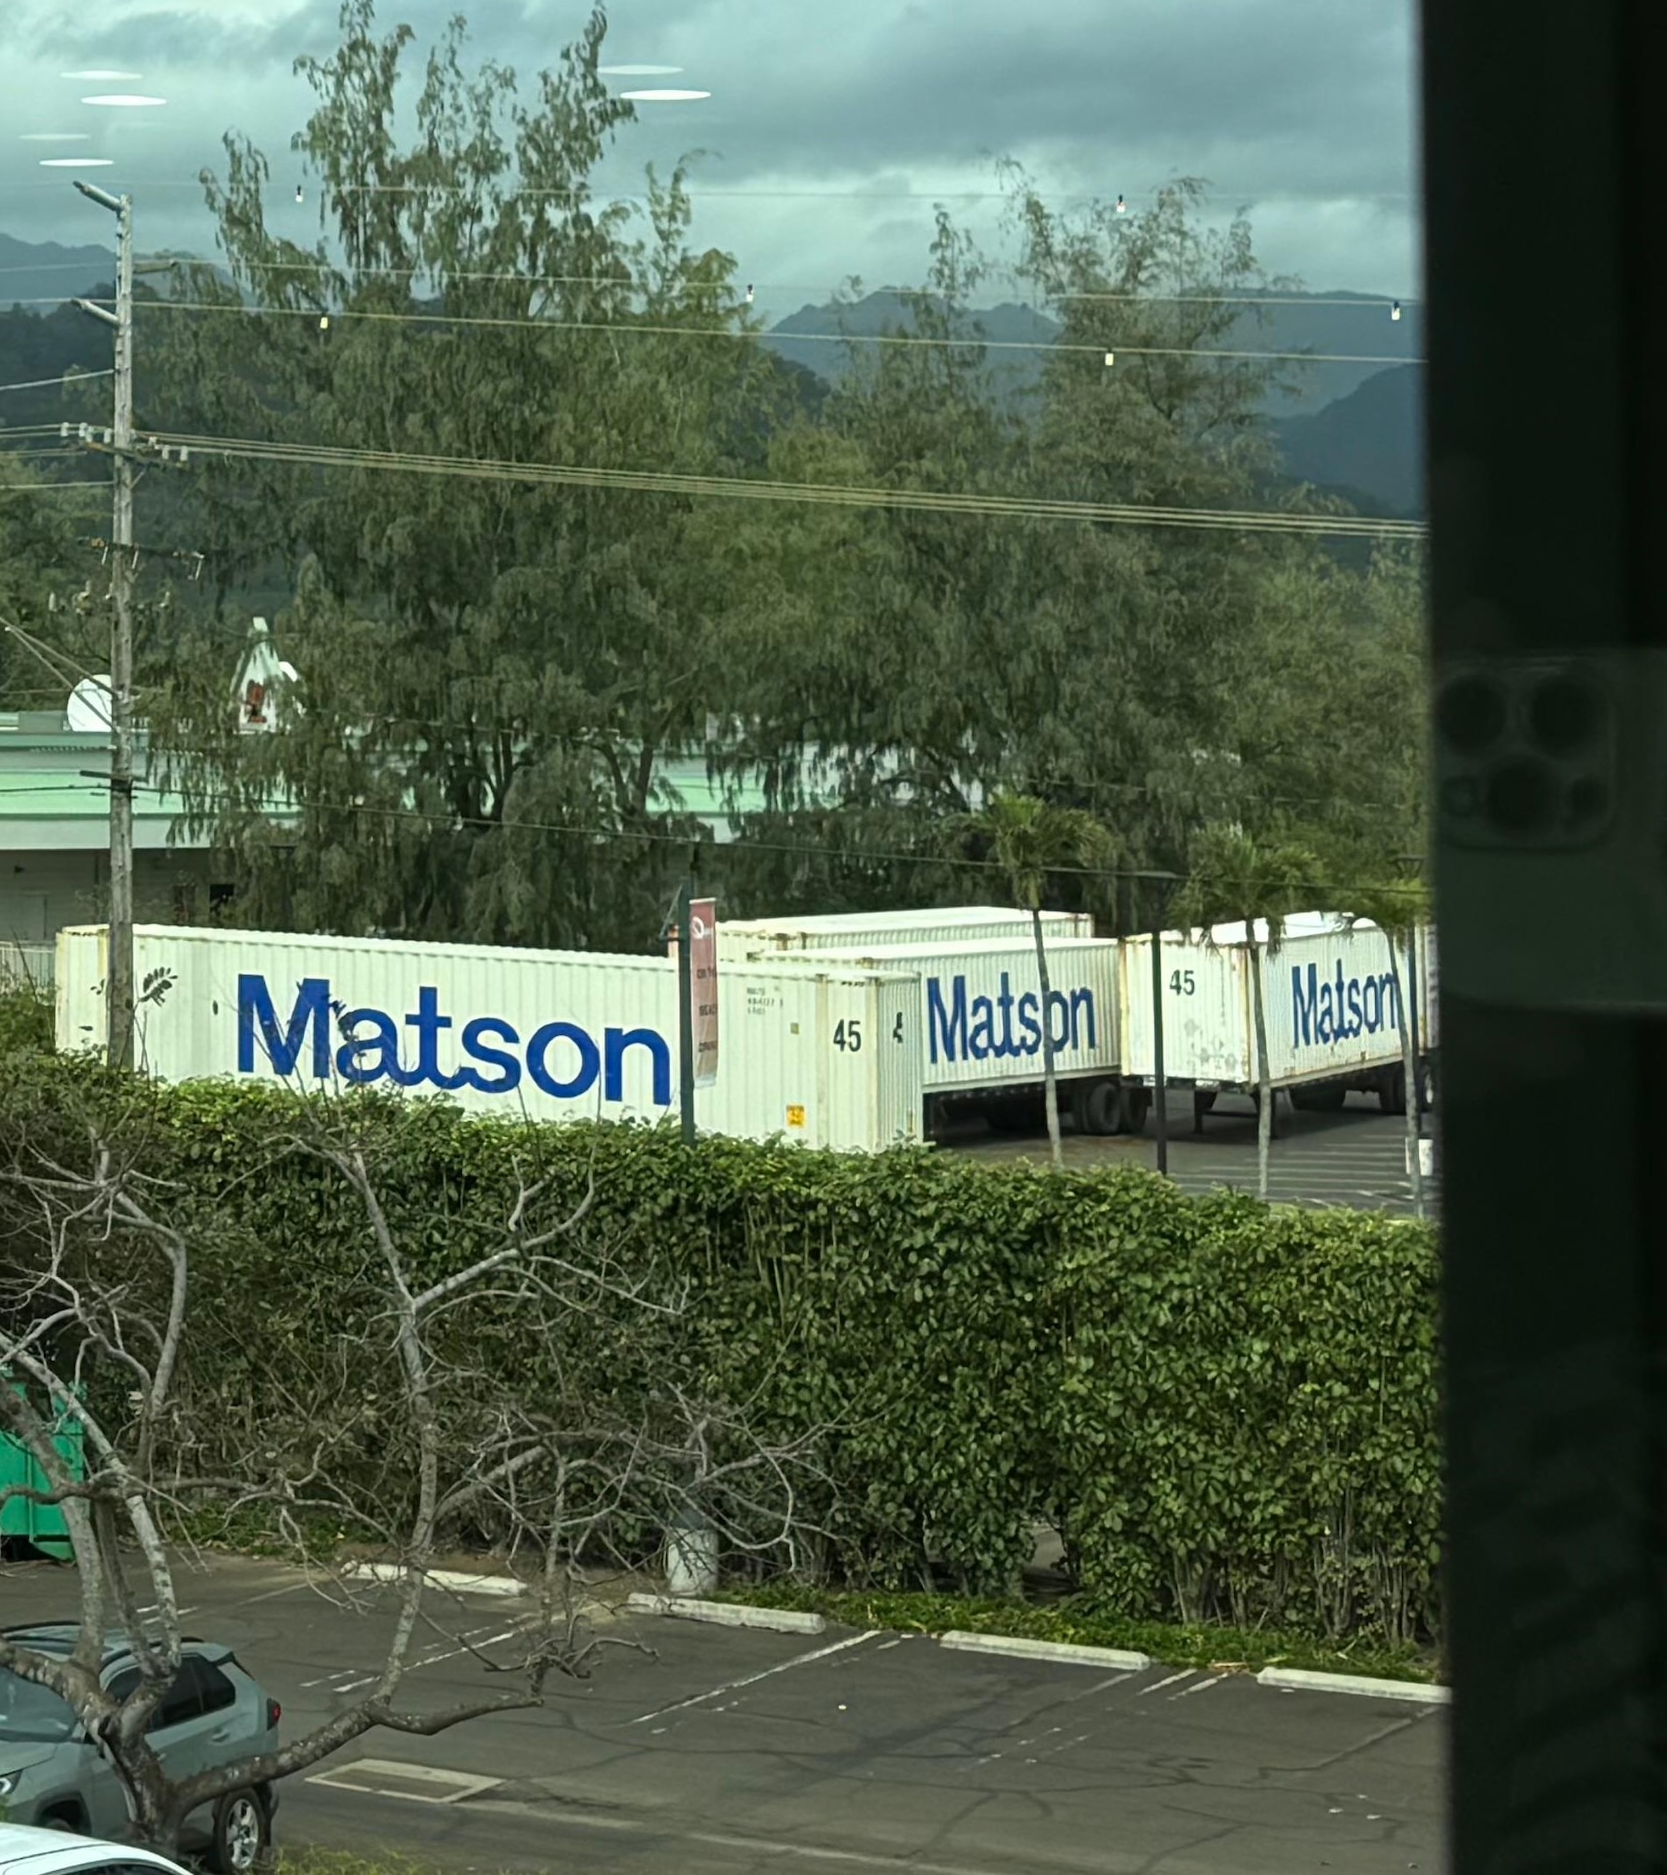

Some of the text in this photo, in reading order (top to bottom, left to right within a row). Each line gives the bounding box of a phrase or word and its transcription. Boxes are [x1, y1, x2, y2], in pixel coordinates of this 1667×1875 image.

[927, 972, 1096, 1064] Matson
[1169, 970, 1195, 996] 45
[1292, 958, 1399, 1048] Matson
[238, 973, 671, 1107] Matson
[833, 1019, 862, 1052] 45
